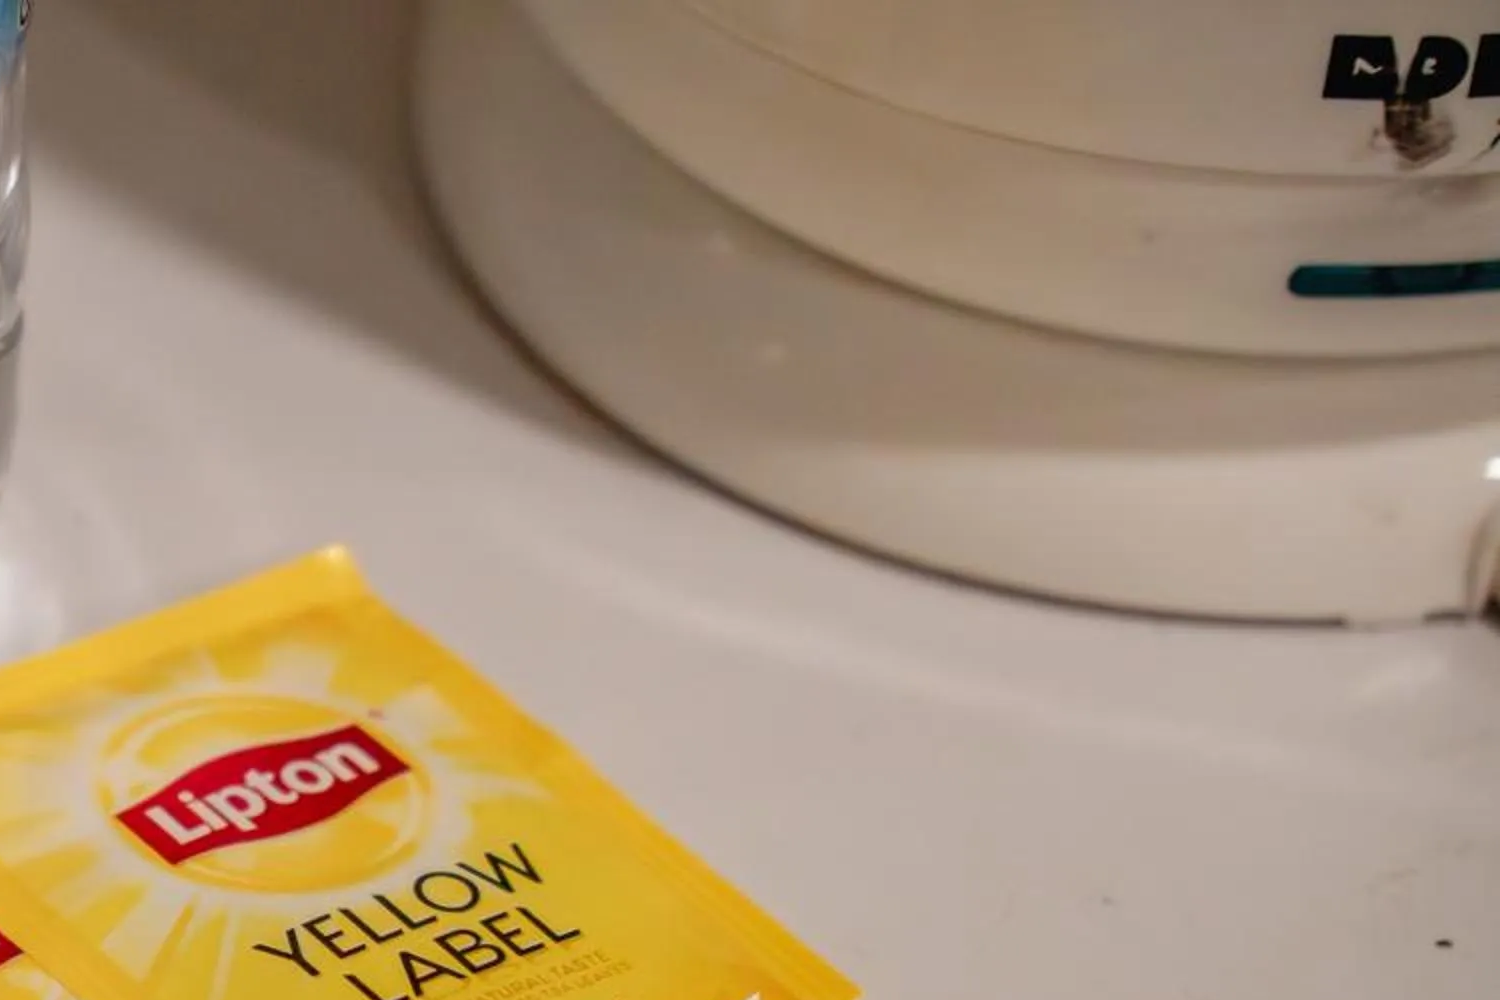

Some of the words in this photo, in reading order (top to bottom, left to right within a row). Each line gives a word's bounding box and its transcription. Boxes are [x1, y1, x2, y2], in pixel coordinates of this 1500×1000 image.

[143, 738, 381, 846] Lipton
[252, 843, 544, 977] YELLOW
[550, 950, 611, 979] TASTE
